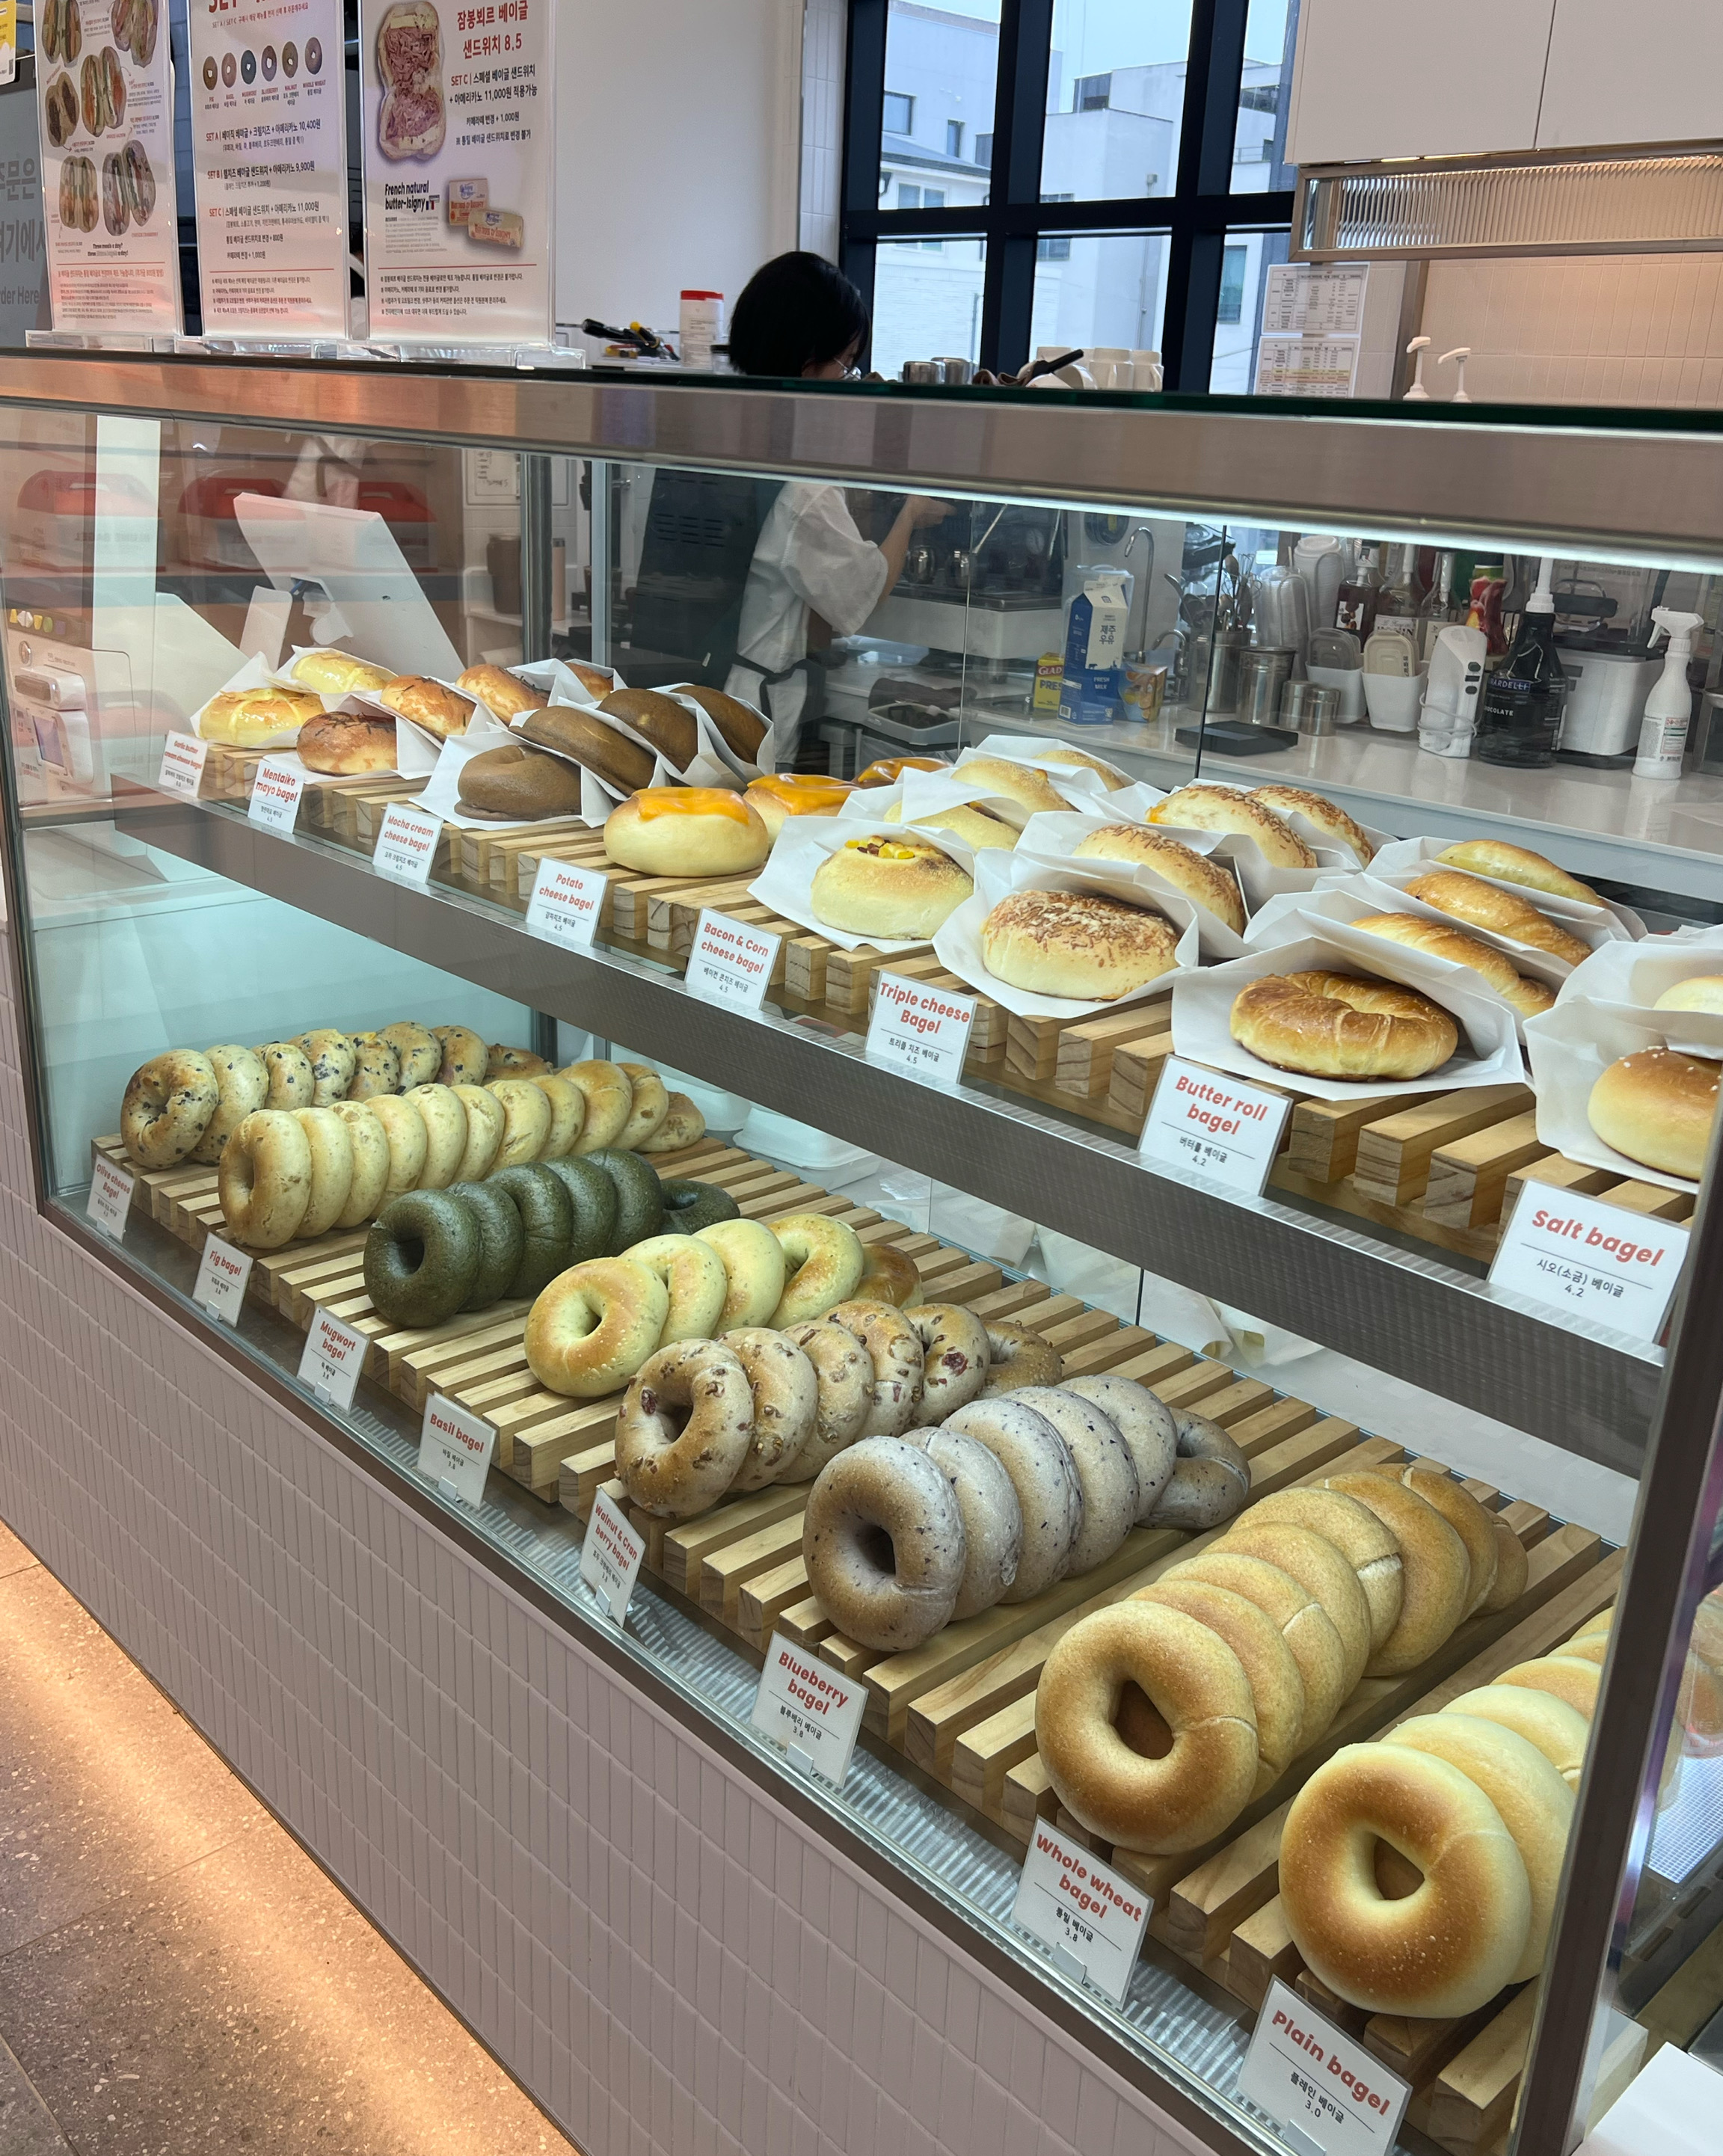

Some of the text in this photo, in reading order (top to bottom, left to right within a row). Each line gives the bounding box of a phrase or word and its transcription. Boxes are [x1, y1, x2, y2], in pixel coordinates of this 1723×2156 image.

[458, 0, 528, 31] 잠봉뵈르 베이글
[463, 33, 522, 59] 샌드위치 8.5
[451, 64, 535, 86] SET C 스페셜 베이글 샌드위치
[455, 91, 482, 105] 아메리카노
[485, 86, 512, 101] 11,000원
[513, 84, 538, 98] 적용가능
[485, 114, 494, 125] 변경
[500, 111, 520, 123] 1,000원
[206, 132, 215, 141] SET
[215, 132, 219, 141] A
[236, 128, 248, 139] 베이글
[254, 126, 271, 137] 크림치즈
[275, 122, 298, 135] 아메리카노
[299, 118, 321, 131] 10,400원
[462, 129, 531, 146] 통밀 베이글 샌드위치로 변경 불가
[207, 171, 216, 179] SET
[217, 170, 220, 178] B
[237, 167, 250, 178] 베이글
[251, 165, 268, 177] 샌드위치
[273, 163, 295, 175] 아메리카노
[296, 161, 315, 172] 9,900원
[384, 180, 429, 196] French natural
[209, 201, 319, 217] SET C 스페셜 베이글 샌드위치 아메리카노 11,000원
[385, 195, 426, 212] butter-Isigny
[17, 286, 39, 304] Here
[1099, 634, 1114, 645] 우유
[1100, 625, 1116, 635] 제주
[1038, 666, 1062, 675] GLAD
[262, 768, 295, 786] Mentaiko
[256, 782, 298, 802] mayo bagel
[387, 815, 434, 837] Mocha cream
[384, 830, 430, 852] cheese bagel
[393, 855, 406, 863] 크림치즈
[408, 859, 418, 868] 베이글
[556, 873, 583, 890] Potato
[539, 886, 595, 910] cheese bagel
[546, 912, 576, 927] 감자치즈 베이글
[704, 922, 769, 957] Bacon & Corn
[701, 941, 764, 974] cheese bagel
[704, 967, 749, 993] 베이컨 콘치즈 베이글
[719, 984, 728, 993] 4.5
[880, 983, 970, 1022] Triple cheese
[900, 1010, 942, 1034] Bagel
[889, 1037, 940, 1063] 트리플 치즈 베이글
[906, 1055, 918, 1064] 4.5
[1176, 1075, 1268, 1121] Butter roll
[1187, 1103, 1241, 1134] bagel
[1179, 1136, 1227, 1164] 버터롤 베이글
[1192, 1155, 1207, 1167] 4.2
[96, 1164, 111, 1179] Olive
[102, 1182, 120, 1199] Bagel
[1532, 1210, 1665, 1267] Salt bagel
[209, 1250, 242, 1276] Fig bagel
[1537, 1259, 1624, 1298] 시오(소금) 베이글
[1564, 1284, 1584, 1297] 4.2
[320, 1321, 356, 1351] Mugwort
[322, 1338, 346, 1360] bagel
[325, 1365, 336, 1376] 베이글
[430, 1413, 485, 1453] Basil bagel
[442, 1449, 464, 1467] 바질 베이글
[448, 1461, 456, 1470] 3.8
[595, 1504, 637, 1560] Walnut & Cran
[595, 1524, 630, 1571] berry bagel
[612, 1572, 621, 1590] 베이글
[778, 1651, 849, 1709] Blueberry
[787, 1678, 830, 1716] bagel
[780, 1705, 823, 1741] 블루베리 베이글
[793, 1725, 804, 1738] 3.8
[1036, 1833, 1143, 1922] Whole wheat
[1058, 1873, 1108, 1919] bagel
[1056, 1906, 1094, 1943] 통밀 베이글
[1065, 1927, 1078, 1942] 3.8
[1271, 2009, 1391, 2116] Plain bagel
[1290, 2071, 1345, 2125] 플레인 베이글
[1304, 2099, 1321, 2118] 3.0
